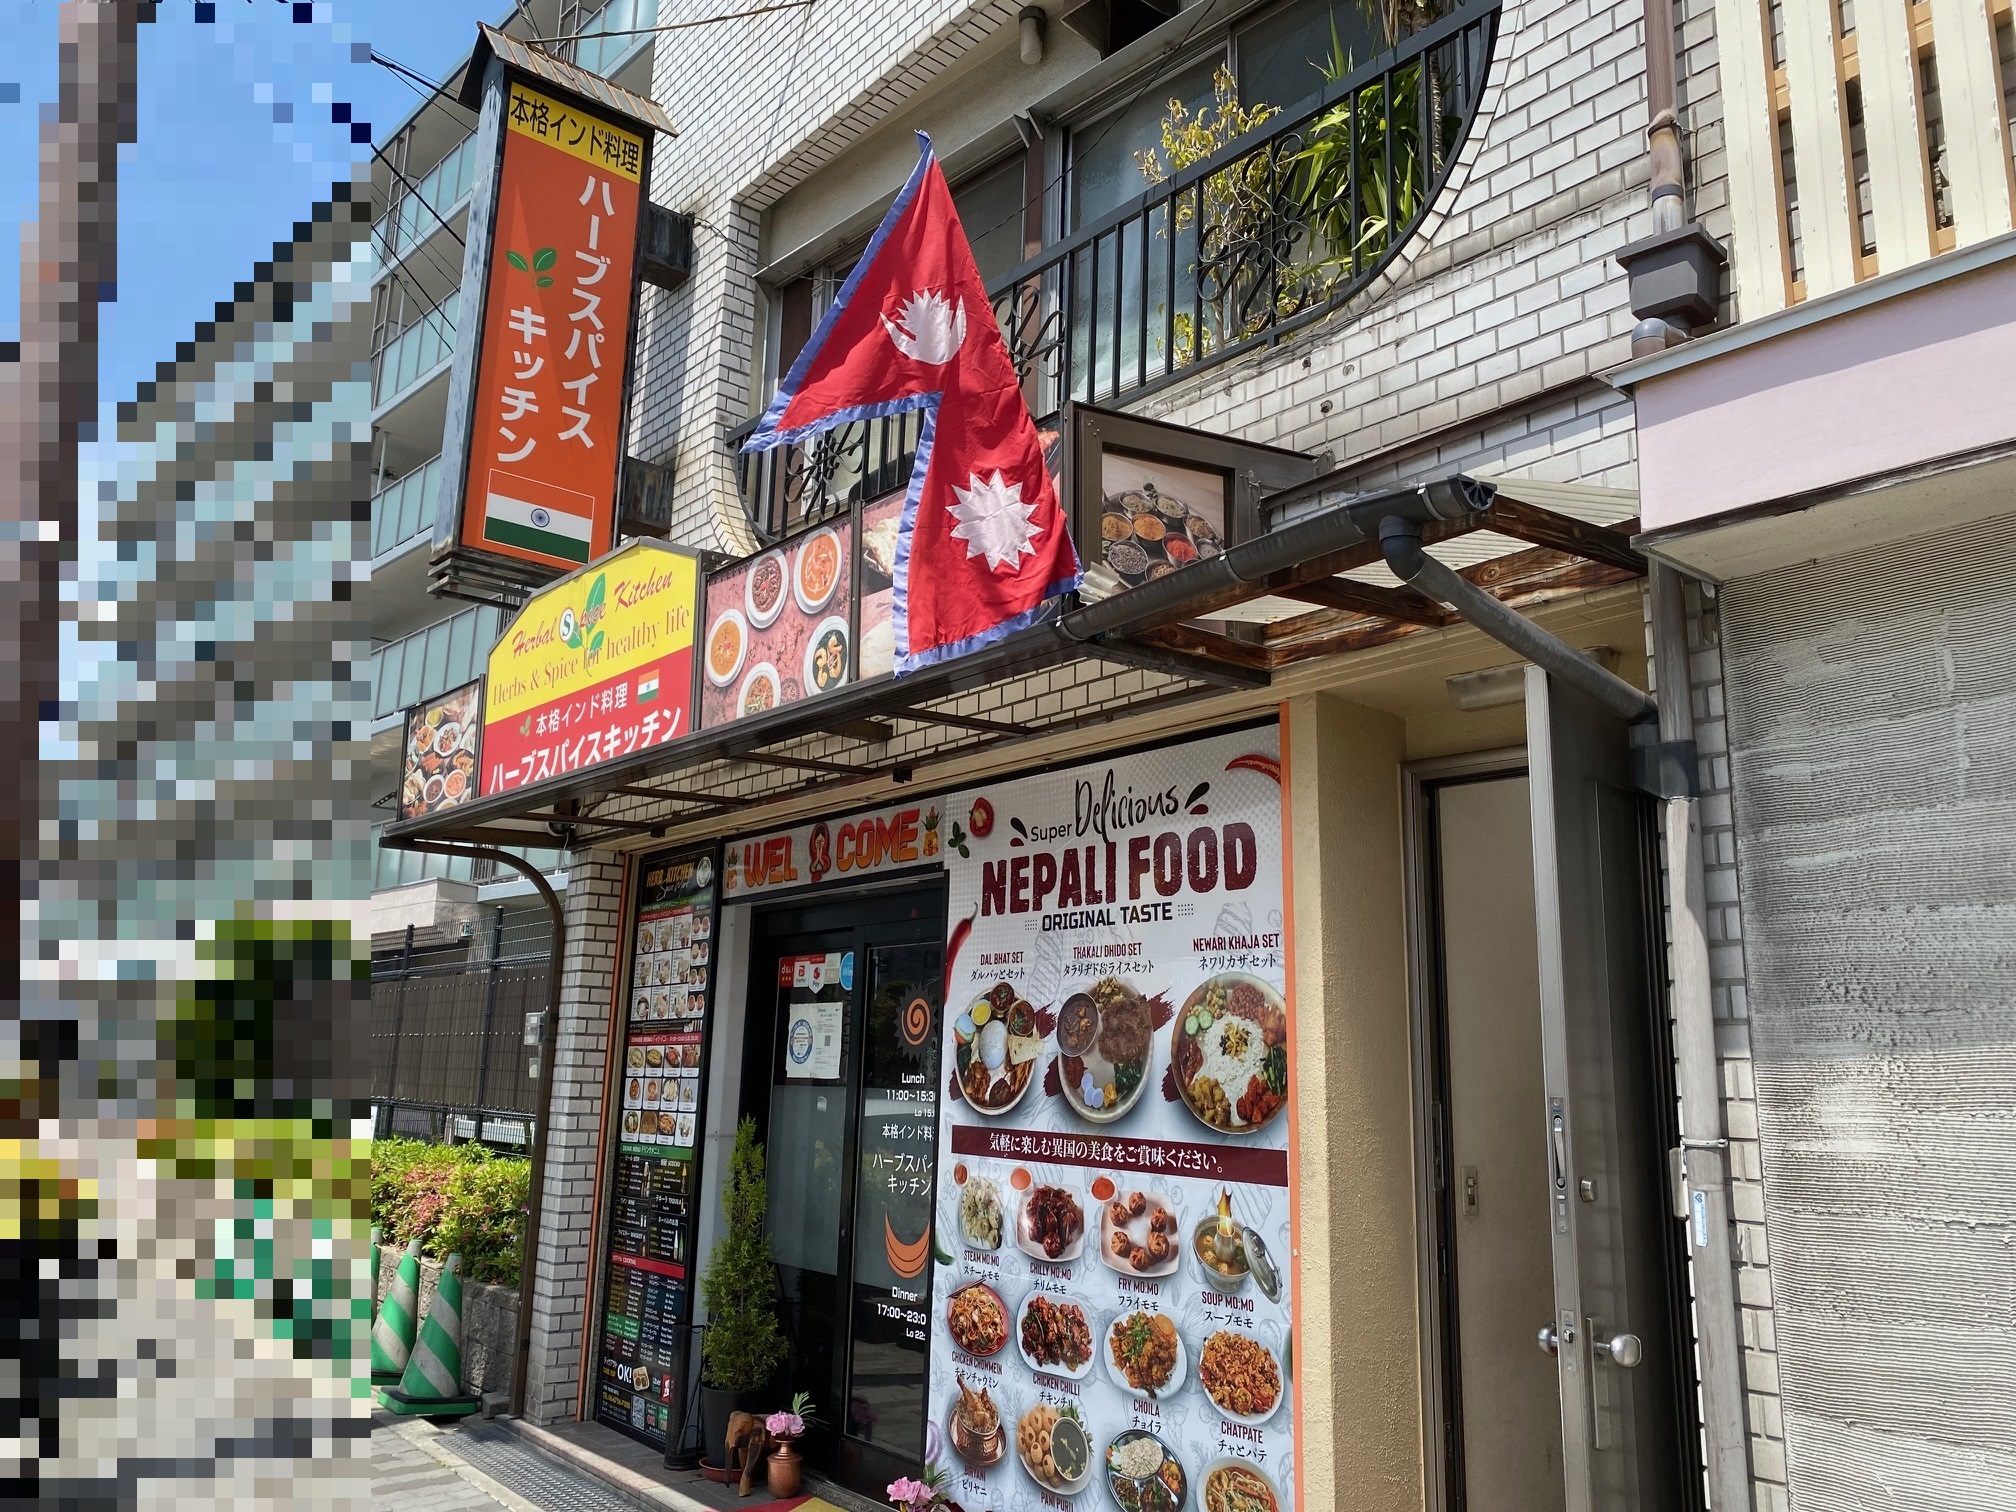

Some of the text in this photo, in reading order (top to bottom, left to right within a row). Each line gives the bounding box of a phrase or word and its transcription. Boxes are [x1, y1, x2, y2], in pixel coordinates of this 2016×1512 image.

[510, 92, 640, 176] 本格インド料理
[557, 174, 616, 450] ハーブスパイス
[496, 305, 547, 464] キッチン
[512, 617, 557, 659] Herbal
[613, 567, 673, 614] Kitchen
[493, 676, 526, 706] Herbs
[530, 668, 541, 692] &
[544, 654, 579, 689] Spice
[606, 620, 661, 661] healthy
[665, 604, 690, 637] life
[535, 681, 628, 738] 本格インド料理
[489, 705, 682, 796] ハーブスパイスキッチン
[1030, 768, 1179, 846] Super Delicious
[743, 808, 921, 888] WEL COME
[981, 821, 1257, 917] NEPALI FOOD
[1042, 902, 1173, 932] ORIGINAL TASTE
[1073, 942, 1142, 960] THAKALI DHIDO SET
[1193, 933, 1280, 952] NEWARI KHAJA SET
[980, 951, 1024, 966] DAL BHAT SET
[1199, 953, 1276, 971] ネワリカザセット
[901, 1072, 925, 1084] Lunch
[886, 1090, 935, 1102] 11:00~15:3
[882, 1122, 934, 1142] 本格インド料
[988, 1132, 1223, 1173] 気軽に楽しむ異国の美食をご賞味ください。
[887, 1174, 931, 1196] キッチン
[963, 1250, 1000, 1267] STEAM MO:MO
[963, 1265, 1000, 1281] スチームモモ
[1030, 1262, 1072, 1281] CHILLY MO:MO
[892, 1286, 918, 1302] Dinner
[1033, 1278, 1067, 1295] チリムモモ
[1118, 1277, 1159, 1296] FRY MO:MO
[1118, 1295, 1160, 1311] フライモモ
[1201, 1290, 1254, 1313] SOUP MO:MO
[1204, 1310, 1254, 1329] スープモモ
[906, 1327, 914, 1338] Lo
[951, 1351, 974, 1367] CHICKEN
[617, 1363, 632, 1384] OK!
[954, 1367, 999, 1389] チキンチャウミン
[1032, 1372, 1080, 1396] CHICKEN CHILLI
[1039, 1391, 1073, 1409] チキンチリ
[1133, 1399, 1160, 1418] CHOILA
[1132, 1415, 1162, 1434] チョイラ
[1221, 1421, 1263, 1444] CHATPATE
[964, 1465, 986, 1482] BIRYANI
[1040, 1491, 1056, 1508] PANI
